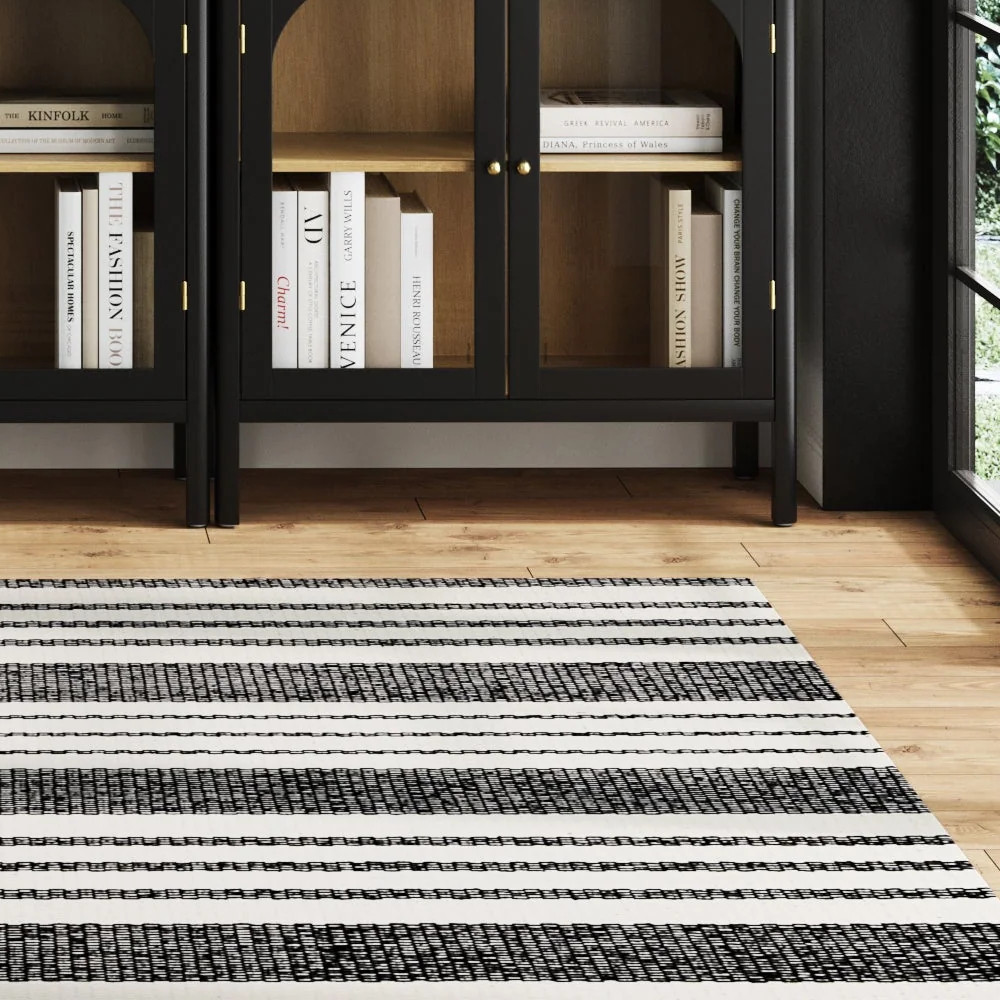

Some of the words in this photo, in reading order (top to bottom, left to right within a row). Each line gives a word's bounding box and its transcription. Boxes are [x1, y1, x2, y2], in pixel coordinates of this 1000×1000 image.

[28, 110, 90, 121] KINFOLK
[562, 119, 588, 128] GREEK
[594, 119, 628, 128] REVIVAL
[634, 119, 670, 128] AMERICA
[543, 140, 578, 150] DIANA,
[582, 140, 624, 150] Princess
[627, 140, 636, 149] of
[640, 140, 668, 149] Wales
[108, 182, 124, 226] THE
[343, 190, 353, 224] WILLS
[733, 198, 742, 229] CHANGE
[343, 226, 353, 262] GARRY
[733, 230, 742, 250] YOUR
[66, 231, 76, 291] SPECTACULAR
[108, 232, 124, 321] FASHION
[733, 251, 742, 274] BRAIN
[411, 276, 422, 308] HENRI
[674, 254, 687, 302] SHOW
[733, 275, 742, 305] CHANGE
[66, 292, 76, 323] HOMES
[276, 275, 291, 330] Charm!
[733, 305, 742, 326] YOUR
[339, 280, 357, 369] VENICE
[411, 311, 422, 366] ROUSSEAU
[733, 327, 742, 348] BODY
[108, 328, 124, 367] BOO
